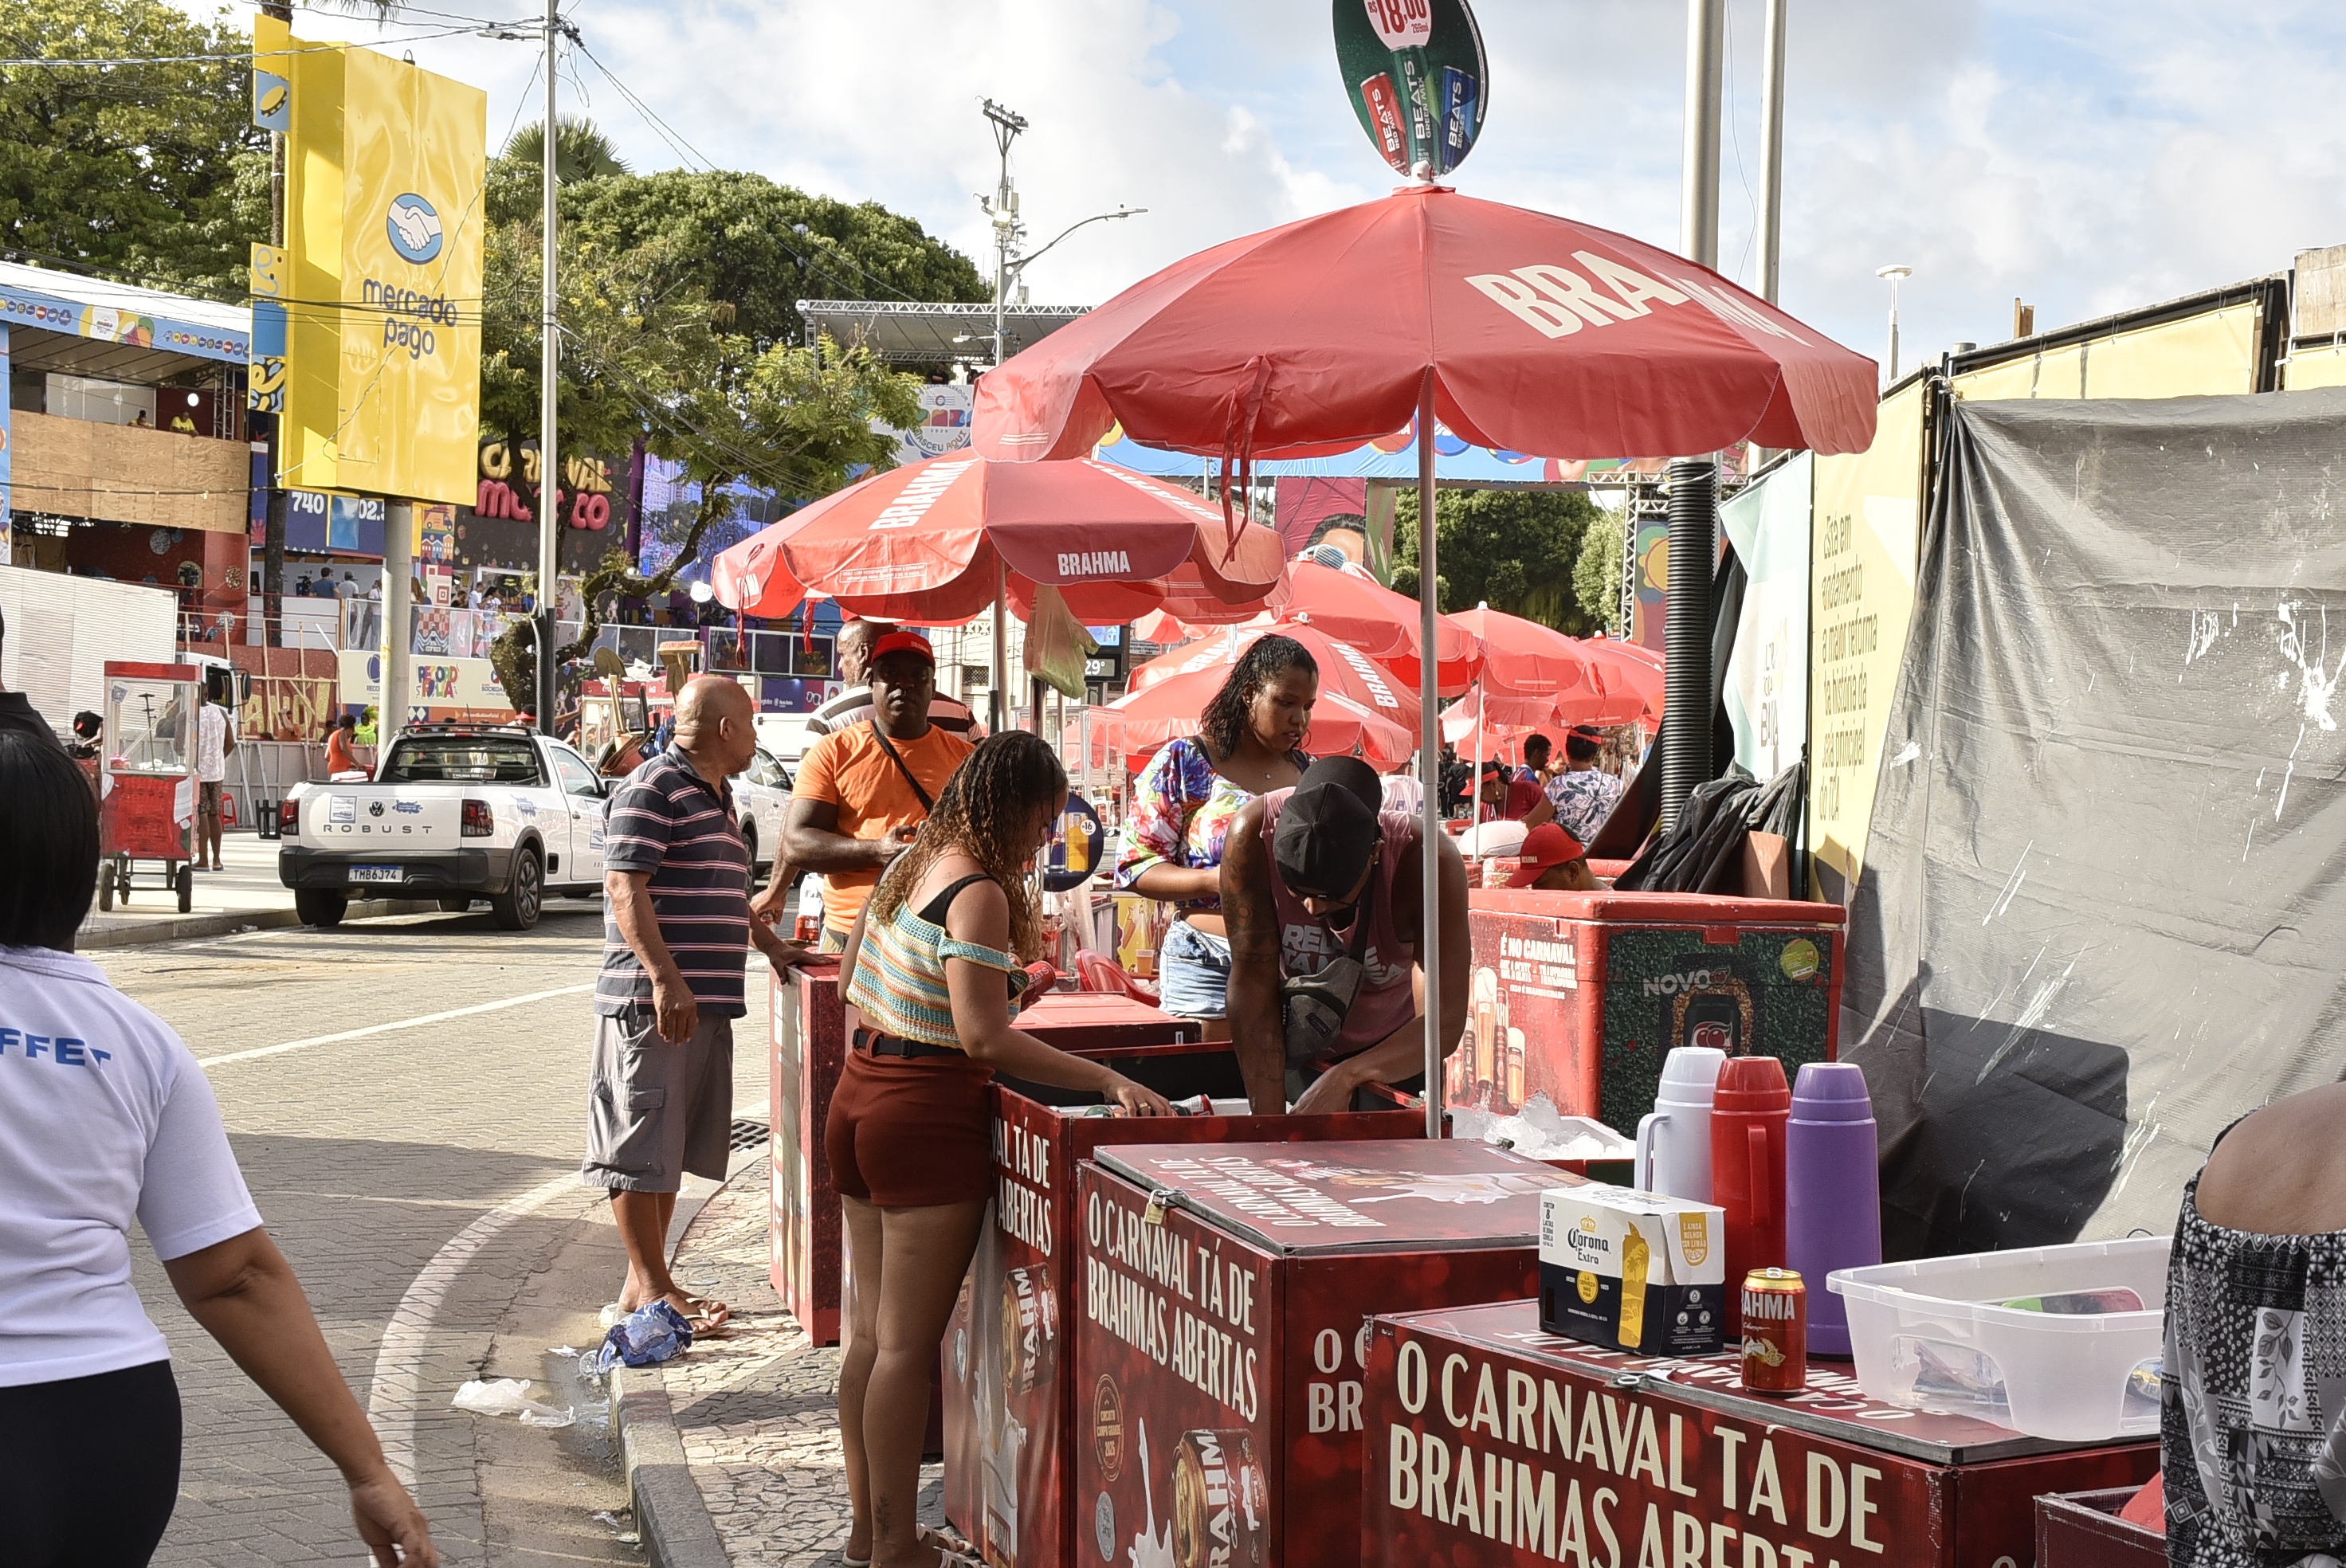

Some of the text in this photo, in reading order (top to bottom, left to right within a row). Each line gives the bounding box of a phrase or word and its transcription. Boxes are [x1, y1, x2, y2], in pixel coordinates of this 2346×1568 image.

[1410, 22, 1429, 34] 269ml
[1371, 88, 1395, 152] BEATS
[1404, 61, 1426, 139] BEATS
[1422, 104, 1431, 139] GREEN
[1449, 81, 1462, 147] BEATS
[363, 278, 457, 327] mercado
[383, 317, 435, 360] pago
[292, 491, 324, 515] 740
[868, 458, 980, 530] BRAHMA
[1839, 514, 1852, 554] em
[1057, 551, 1131, 575] BRAHMA
[1822, 554, 1863, 611] andamento
[1848, 607, 1878, 657] reforma
[418, 665, 459, 684] RECORD
[422, 679, 455, 699] FOLIA
[1329, 642, 1400, 708] BRAHMA
[324, 824, 433, 834] ROBUST
[1500, 931, 1576, 966] É NO CARNAVAL
[1643, 969, 1712, 998] NOVO
[1014, 1115, 1030, 1180] TÁ
[1033, 1134, 1050, 1190] DE
[998, 1175, 1052, 1257] ABERTAS
[1546, 1209, 1551, 1220] 8
[1567, 1227, 1609, 1252] Corona
[1578, 1248, 1599, 1265] Extra
[1089, 1191, 1255, 1336] O CARNAVAL TÁ DE
[1088, 1255, 1257, 1423] BRAHMAS ABERTAS
[1314, 1328, 1342, 1374] O
[1398, 1340, 1428, 1414] O
[1441, 1353, 1697, 1498] CARNAVAL
[1712, 1425, 1788, 1527] TÁ
[1807, 1450, 1885, 1554] DE
[1390, 1423, 1621, 1568] BRAHMAS
